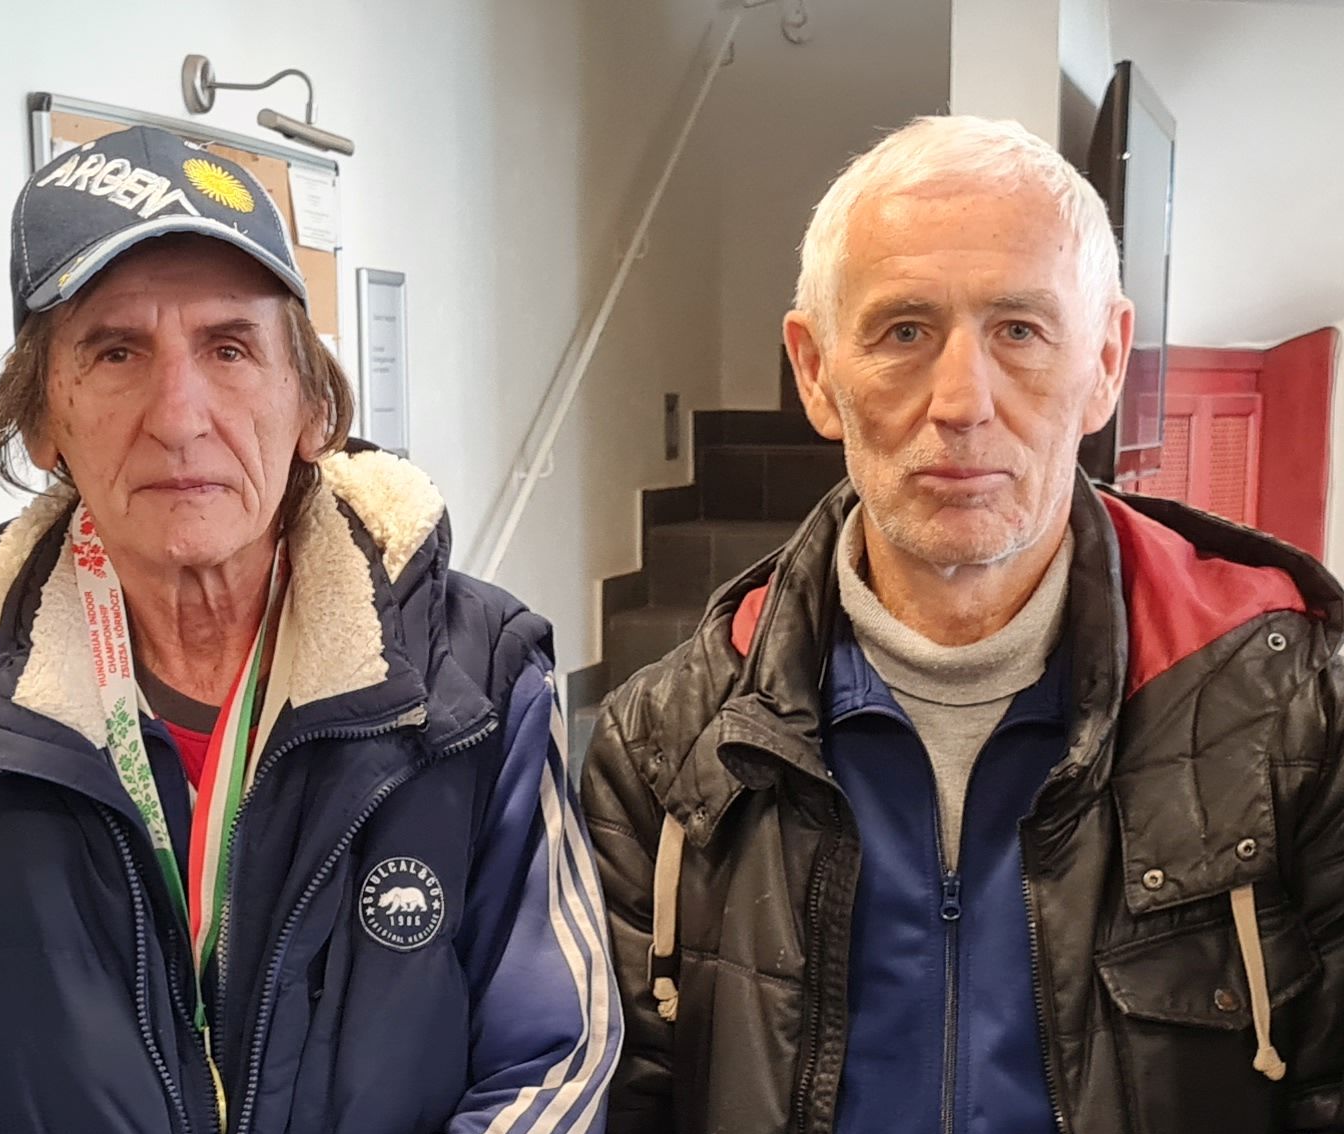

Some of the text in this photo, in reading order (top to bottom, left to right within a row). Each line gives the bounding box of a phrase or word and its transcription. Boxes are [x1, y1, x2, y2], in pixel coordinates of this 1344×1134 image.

[84, 591, 108, 688] HUNGARIAN INDOOR
[98, 603, 117, 674] CHAMPIONSHIP
[117, 641, 131, 679] ZSUZSA
